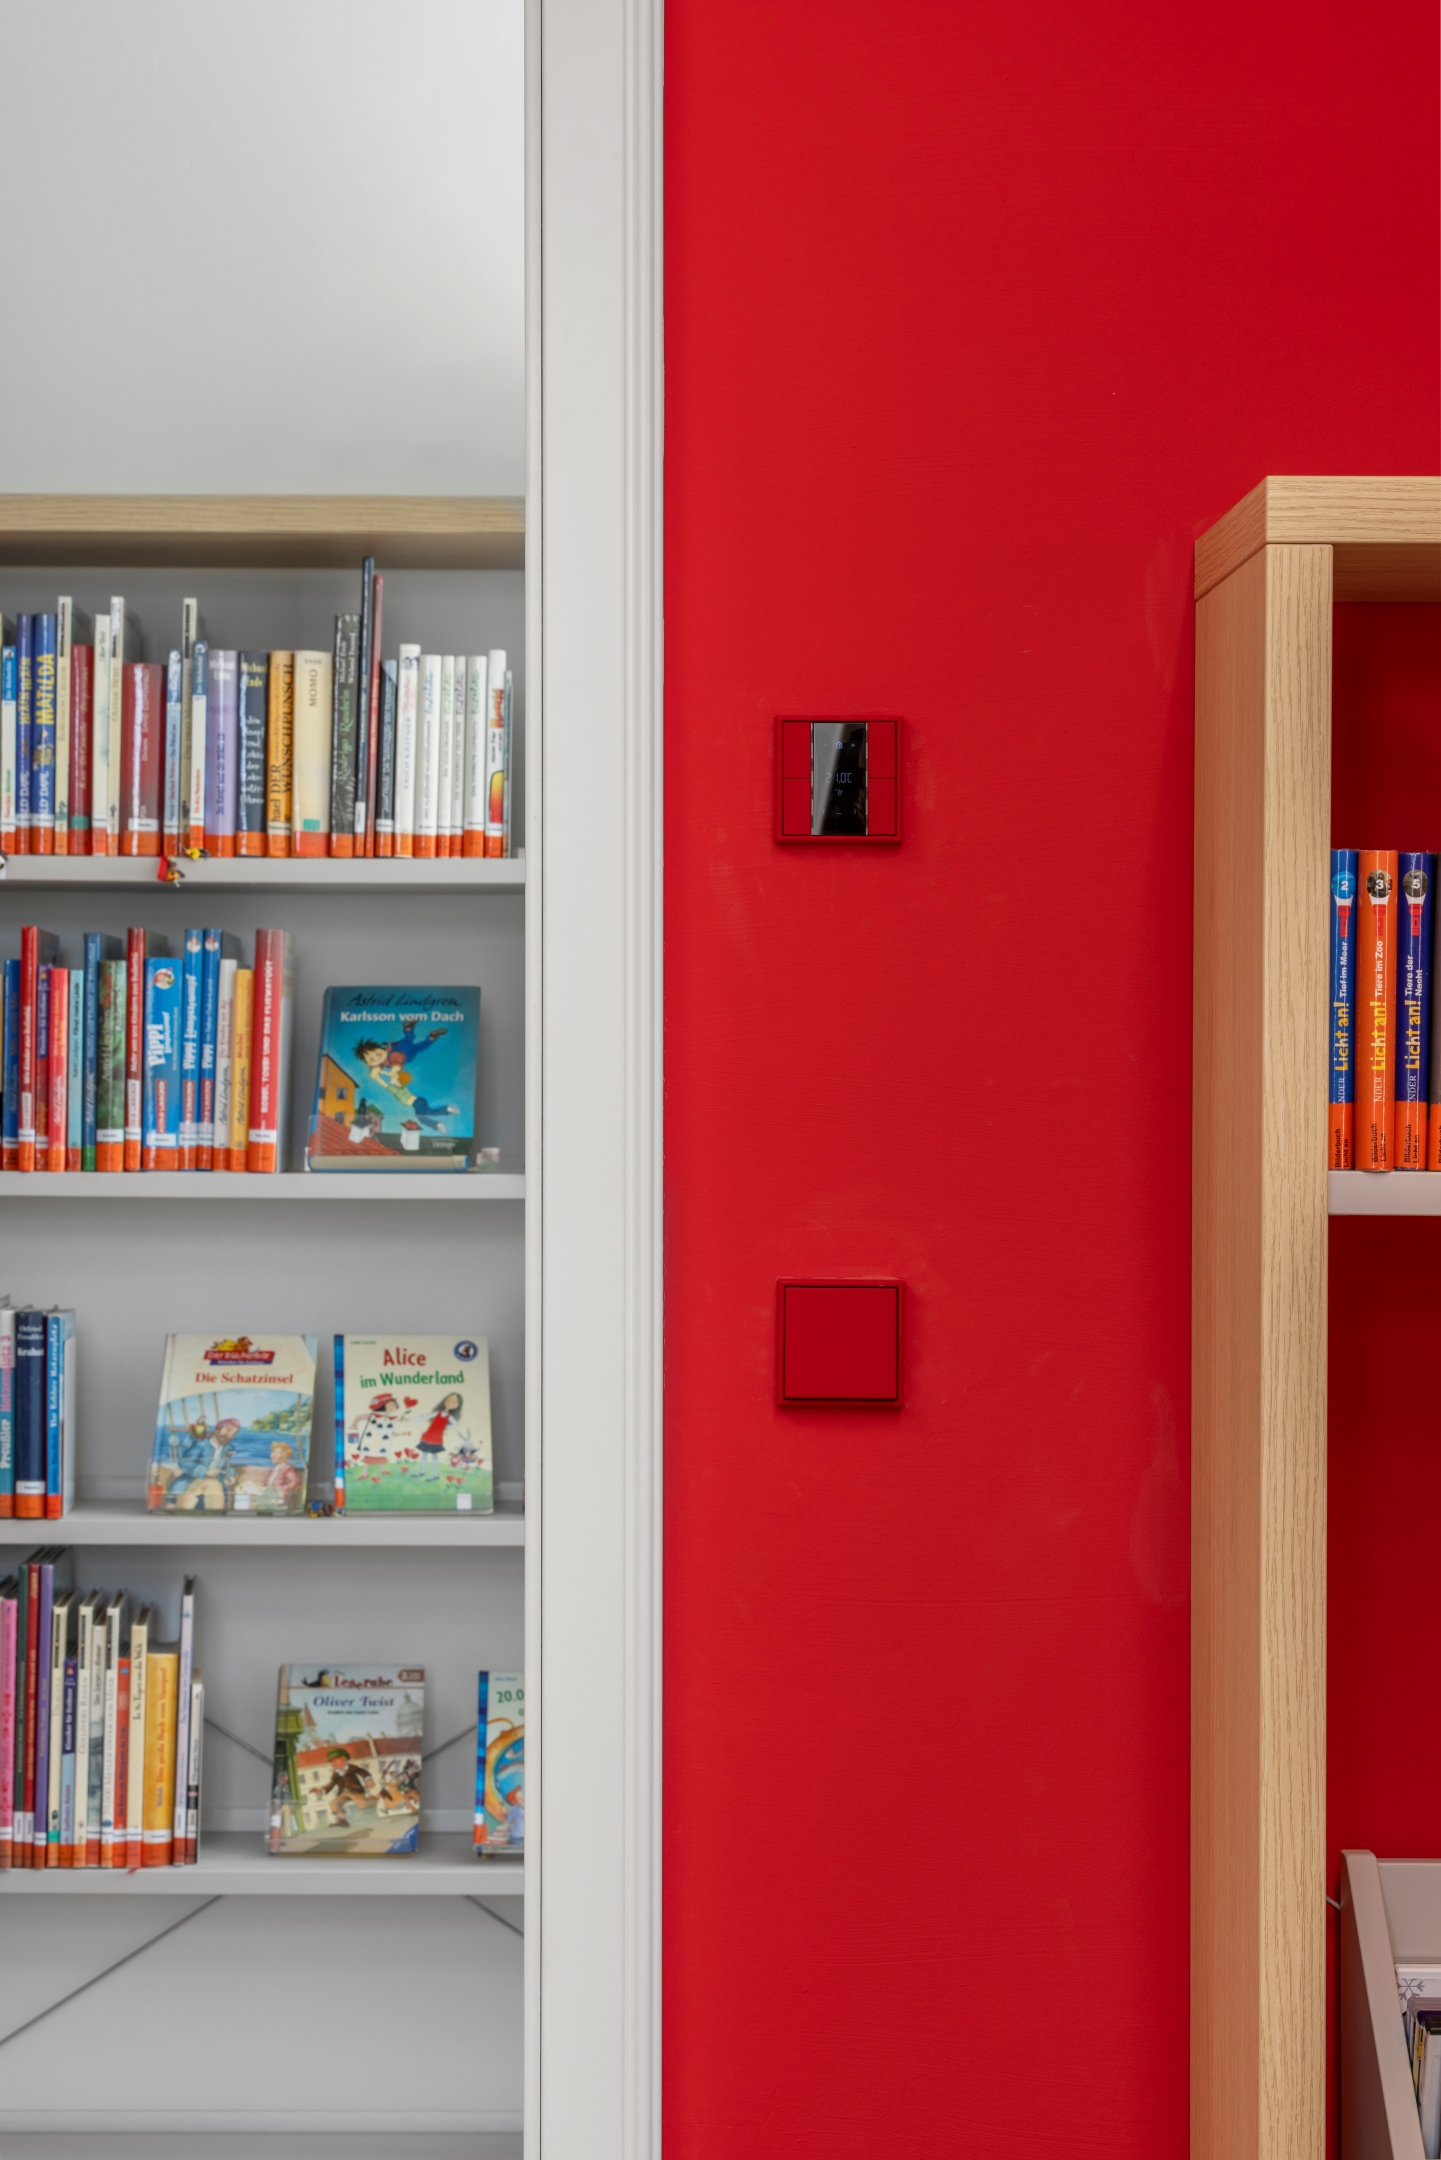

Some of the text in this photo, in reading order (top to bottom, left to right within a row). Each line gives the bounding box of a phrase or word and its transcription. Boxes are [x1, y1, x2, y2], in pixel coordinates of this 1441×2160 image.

[36, 652, 54, 724] MATILDA
[308, 669, 318, 707] MOMO
[283, 663, 293, 793] WUNSCHPUNSCH
[336, 689, 353, 784] Rodrigo Raubein
[40, 771, 49, 796] DAHL
[270, 764, 281, 821] hael DER
[1341, 881, 1348, 890] 2
[1376, 880, 1384, 889] 3
[1412, 879, 1420, 889] 5
[1340, 941, 1348, 965] Meer
[1375, 960, 1383, 971] im
[1341, 967, 1347, 978] im
[1405, 955, 1414, 995] Tiere der
[1415, 968, 1423, 995] Nacht
[263, 960, 273, 1014] FLIEWATÜÜT
[1375, 974, 1383, 997] Tiere
[348, 994, 460, 1010] Astrid Lindgren
[183, 973, 198, 1069] Pippi Langstrumpf
[264, 1016, 272, 1034] DAS
[341, 1011, 464, 1022] Karlsson vom Dach
[147, 1023, 165, 1066] Pippi
[263, 1036, 271, 1055] UND
[1334, 1001, 1350, 1070] Licht an!
[1370, 1001, 1387, 1070] Licht an!
[1404, 1000, 1421, 1069] Licht an!
[202, 1043, 213, 1068] Pippi
[262, 1057, 270, 1081] TOBBI
[261, 1085, 269, 1112] ROBBI,
[1338, 1077, 1346, 1102] NDER
[1375, 1076, 1383, 1102] NDER
[220, 1100, 228, 1125] Astrid
[237, 1100, 246, 1125] Astrid
[1334, 1128, 1342, 1167] Bilderbuch
[1344, 1138, 1349, 1149] an
[1371, 1123, 1379, 1162] Bilderbuch
[1404, 1124, 1413, 1162] Bilderbuch
[383, 1347, 426, 1366] Alice
[195, 1373, 293, 1384] Die Schatzinsel
[360, 1370, 464, 1388] im Wunderland
[50, 1412, 58, 1427] The
[0, 1419, 11, 1468] Preußler
[159, 1667, 168, 1699] Vamperl
[333, 1675, 393, 1689] Leserabe
[313, 1695, 394, 1707] Oliver Twist
[496, 1689, 524, 1703] 20.0
[157, 1721, 166, 1740] Buch
[157, 1742, 167, 1763] große
[156, 1765, 165, 1782] Das
